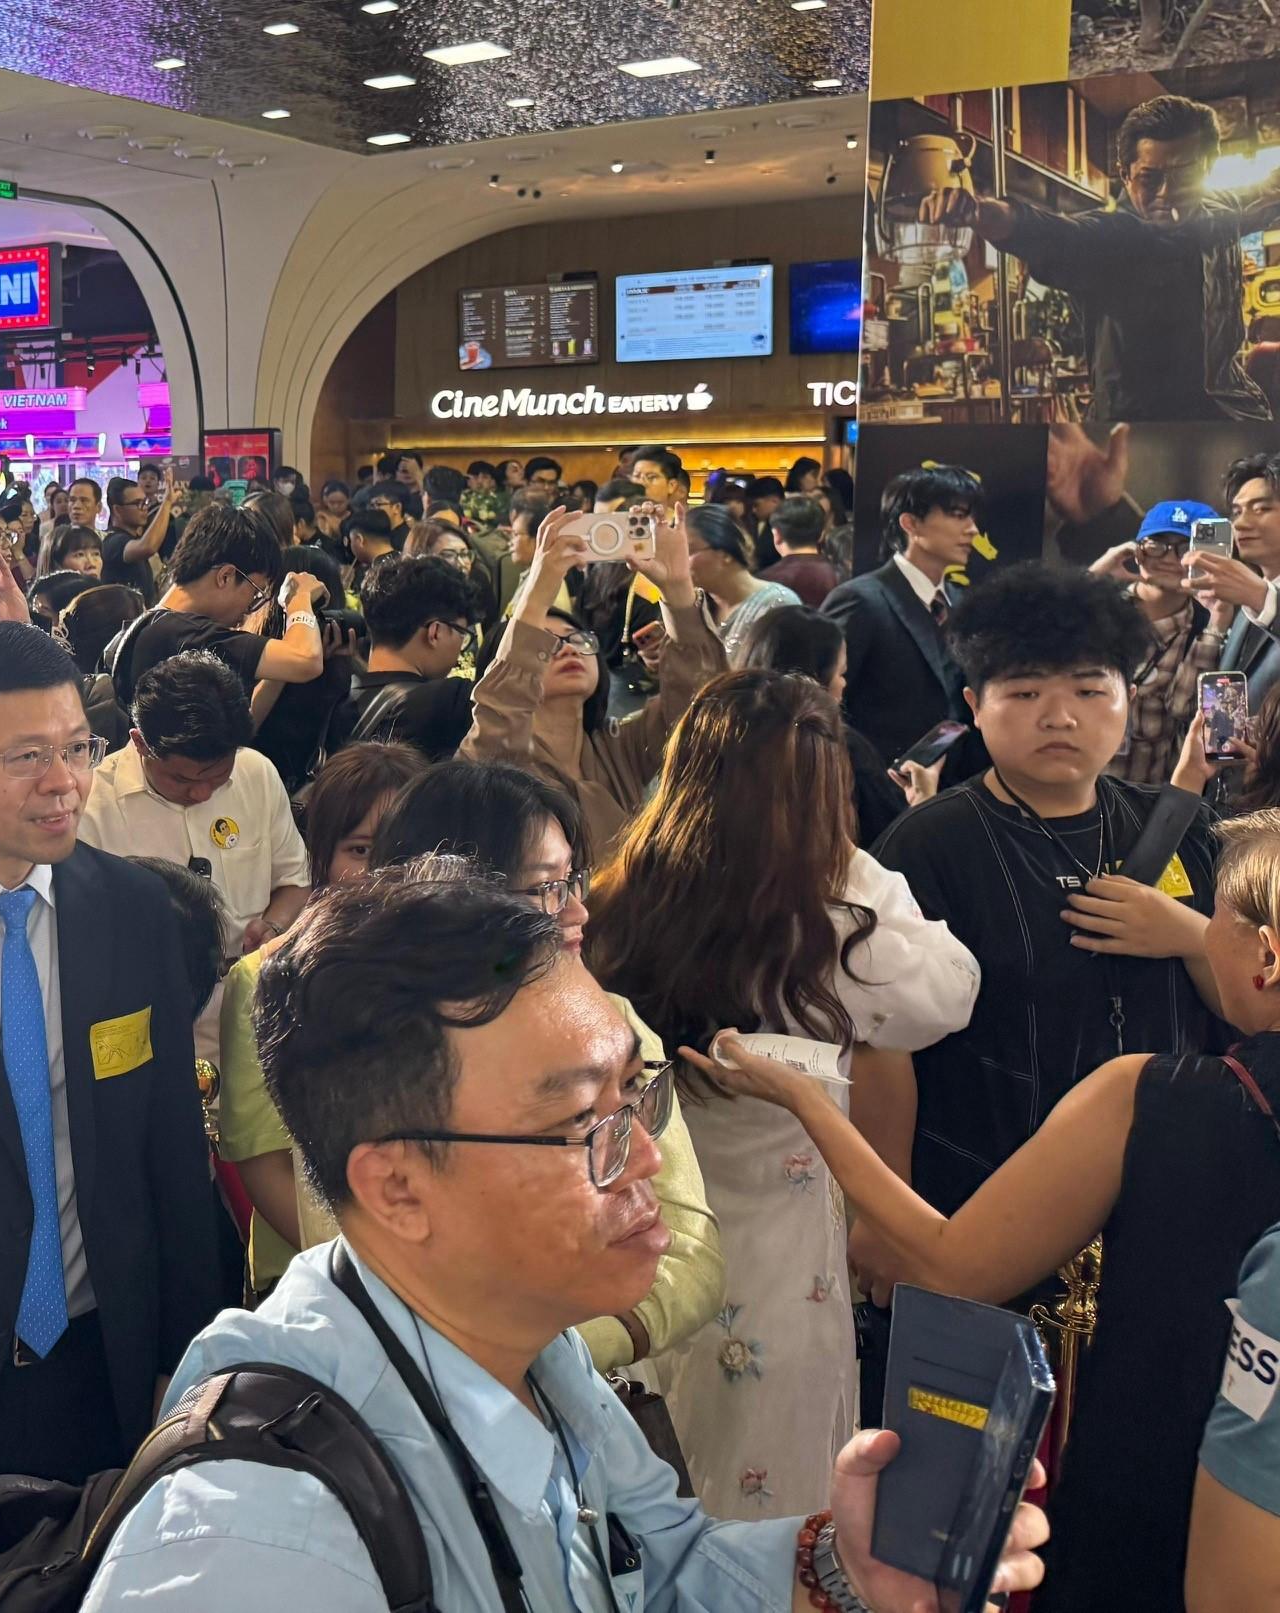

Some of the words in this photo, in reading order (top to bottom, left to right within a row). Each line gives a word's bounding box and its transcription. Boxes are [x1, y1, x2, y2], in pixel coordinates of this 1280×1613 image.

[4, 394, 67, 407] VIETNAM
[432, 385, 606, 418] CineMunch
[608, 394, 683, 414] EATERY
[807, 381, 856, 406] TIC
